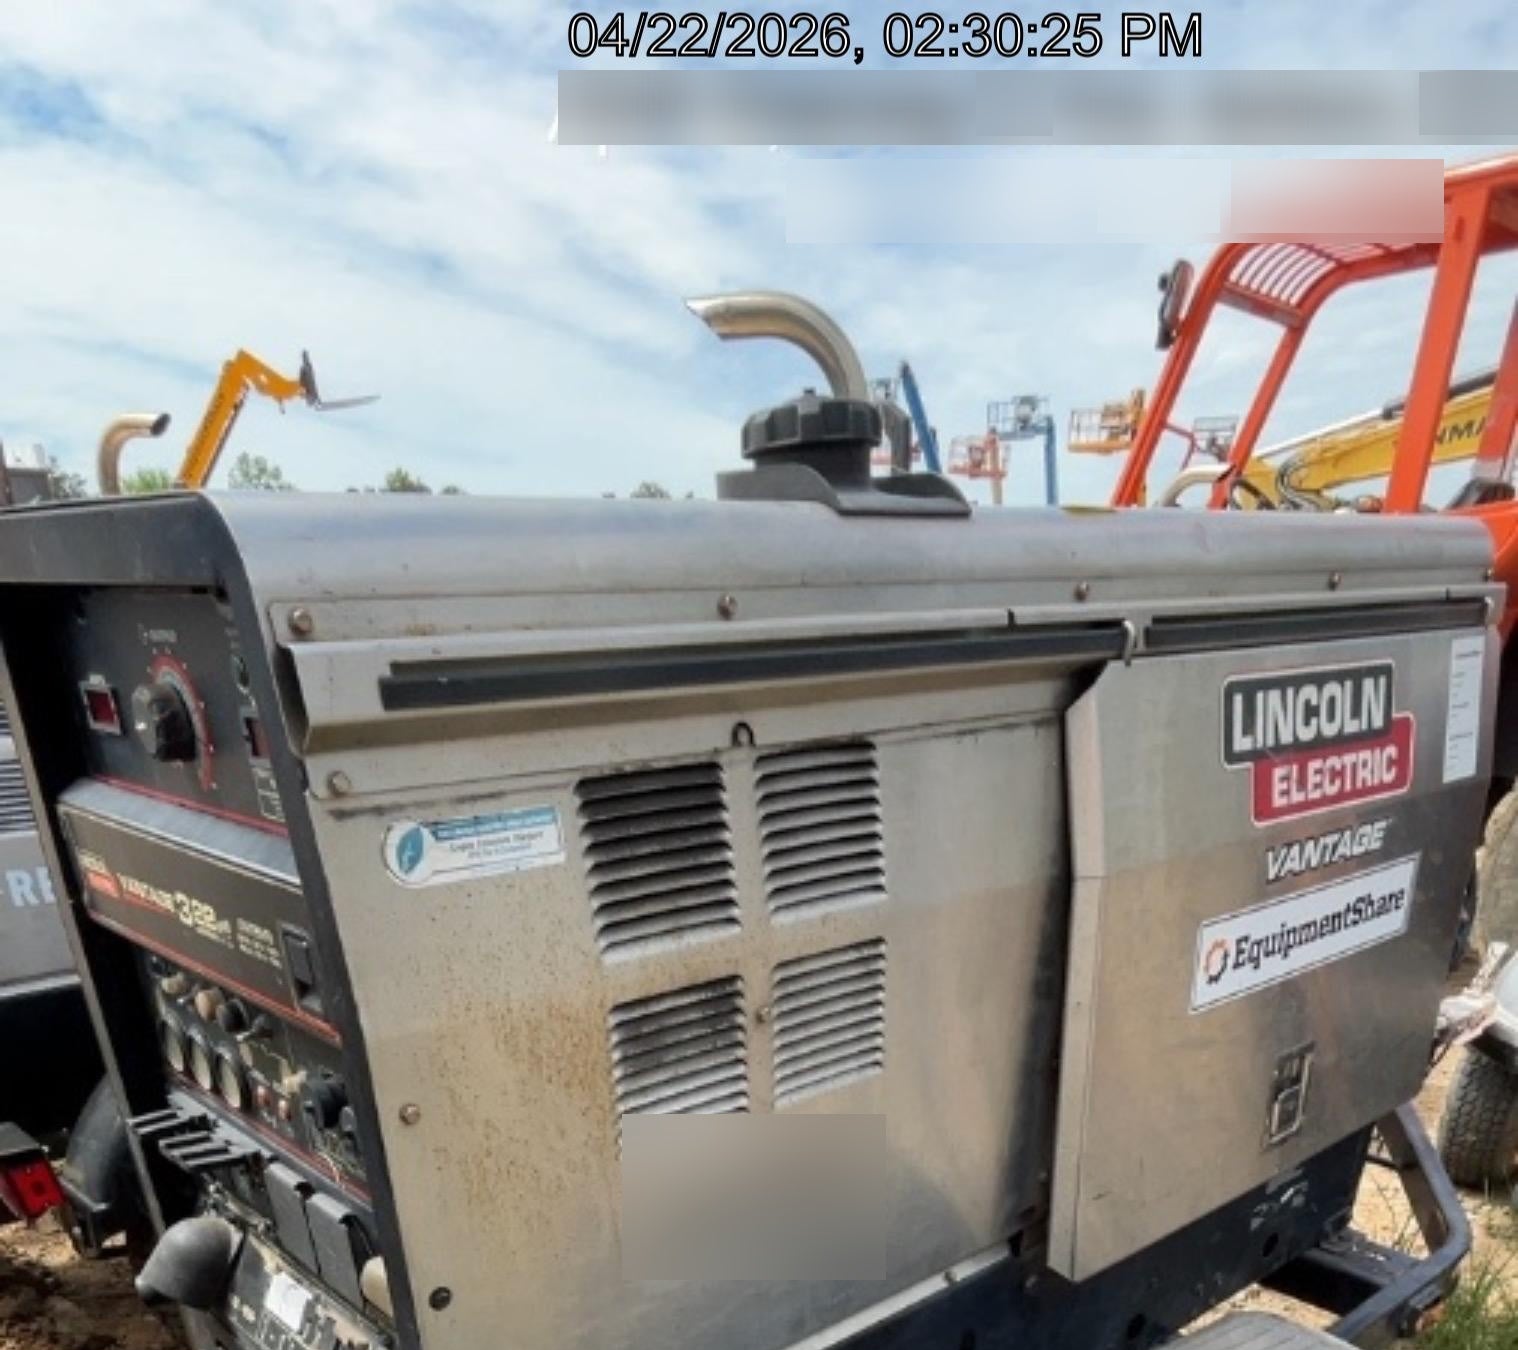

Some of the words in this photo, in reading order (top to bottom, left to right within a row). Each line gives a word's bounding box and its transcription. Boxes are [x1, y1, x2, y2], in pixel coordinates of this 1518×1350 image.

[1232, 674, 1387, 754] LINCOLN
[1271, 745, 1400, 808] ELECTRIC
[1265, 821, 1389, 884] VANTAGE
[1232, 888, 1405, 972] EquipmentShare
